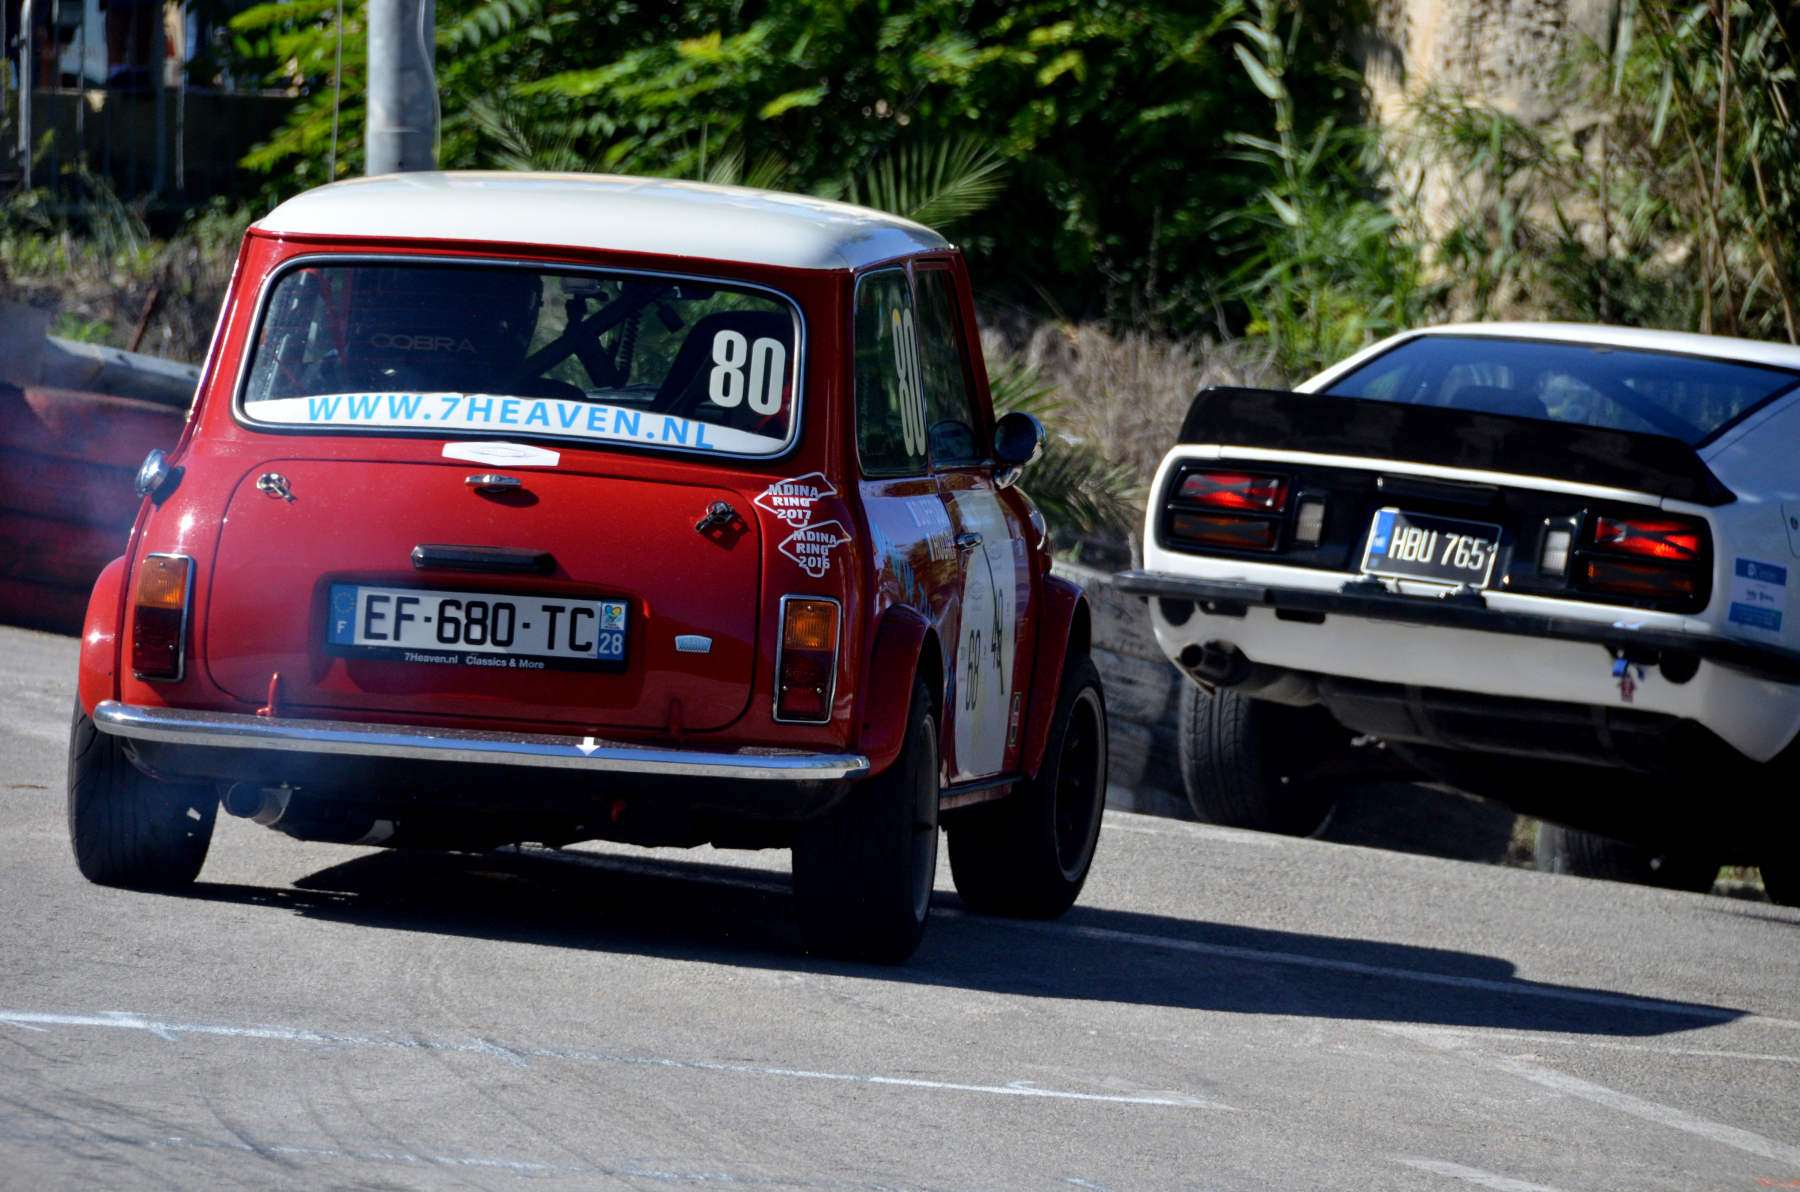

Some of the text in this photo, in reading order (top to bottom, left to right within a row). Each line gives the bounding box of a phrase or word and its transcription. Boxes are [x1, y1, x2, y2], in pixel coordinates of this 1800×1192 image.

[370, 333, 477, 353] COBRA
[708, 329, 786, 416] 80
[892, 308, 926, 457] 80
[307, 395, 715, 450] WWW.7HEAVEN.NL
[768, 484, 819, 498] MDINA
[772, 497, 810, 507] RING
[777, 509, 812, 519] 2017
[793, 530, 837, 544] MDINA
[796, 543, 829, 555] RING
[1388, 526, 1488, 570] HBU 765
[799, 556, 830, 569] 2016
[336, 621, 347, 634] F
[363, 594, 595, 653] EF-680-TC
[599, 632, 623, 655] 28
[404, 652, 545, 669] 7Heaven.nl Classics & More
